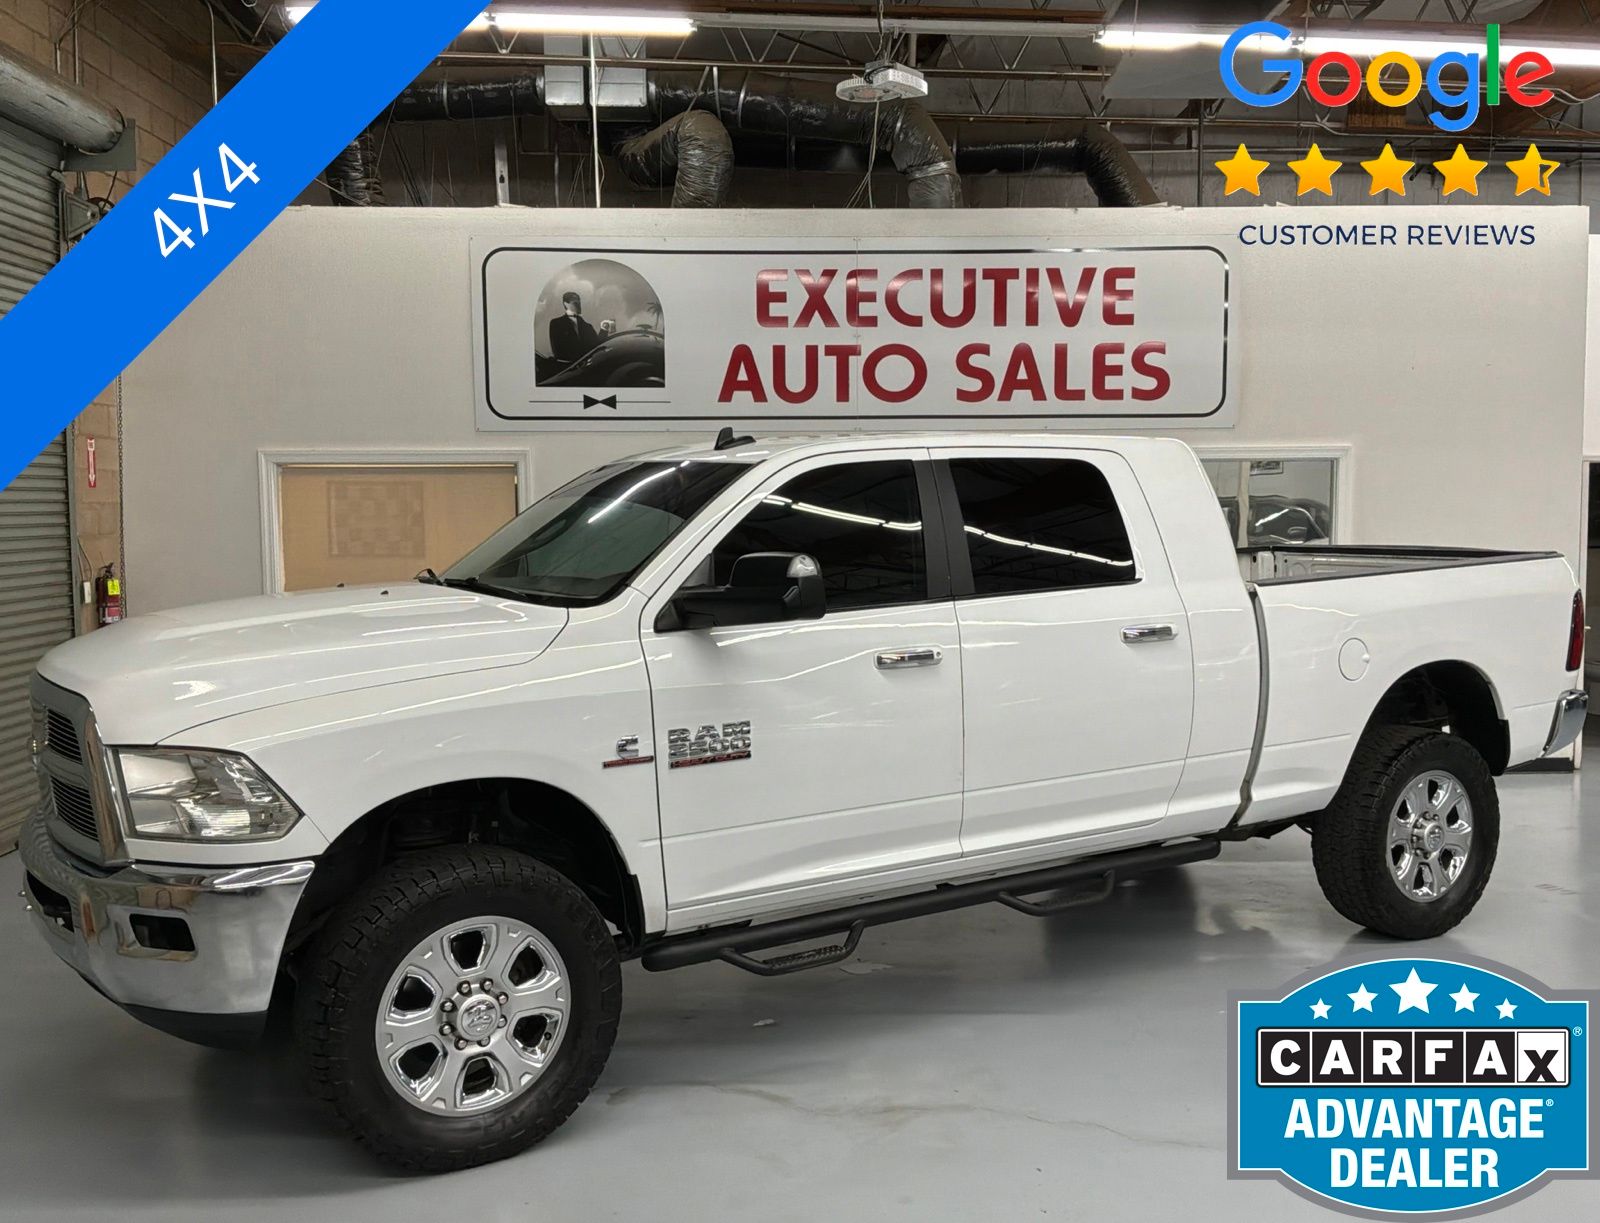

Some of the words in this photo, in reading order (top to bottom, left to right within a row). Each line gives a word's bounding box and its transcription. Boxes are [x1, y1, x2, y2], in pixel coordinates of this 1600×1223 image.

[755, 266, 1136, 328] EXECUTIVE
[718, 342, 928, 404] AUTO
[955, 341, 1171, 403] SALES
[668, 720, 751, 744] RAM
[668, 736, 752, 760] 2500
